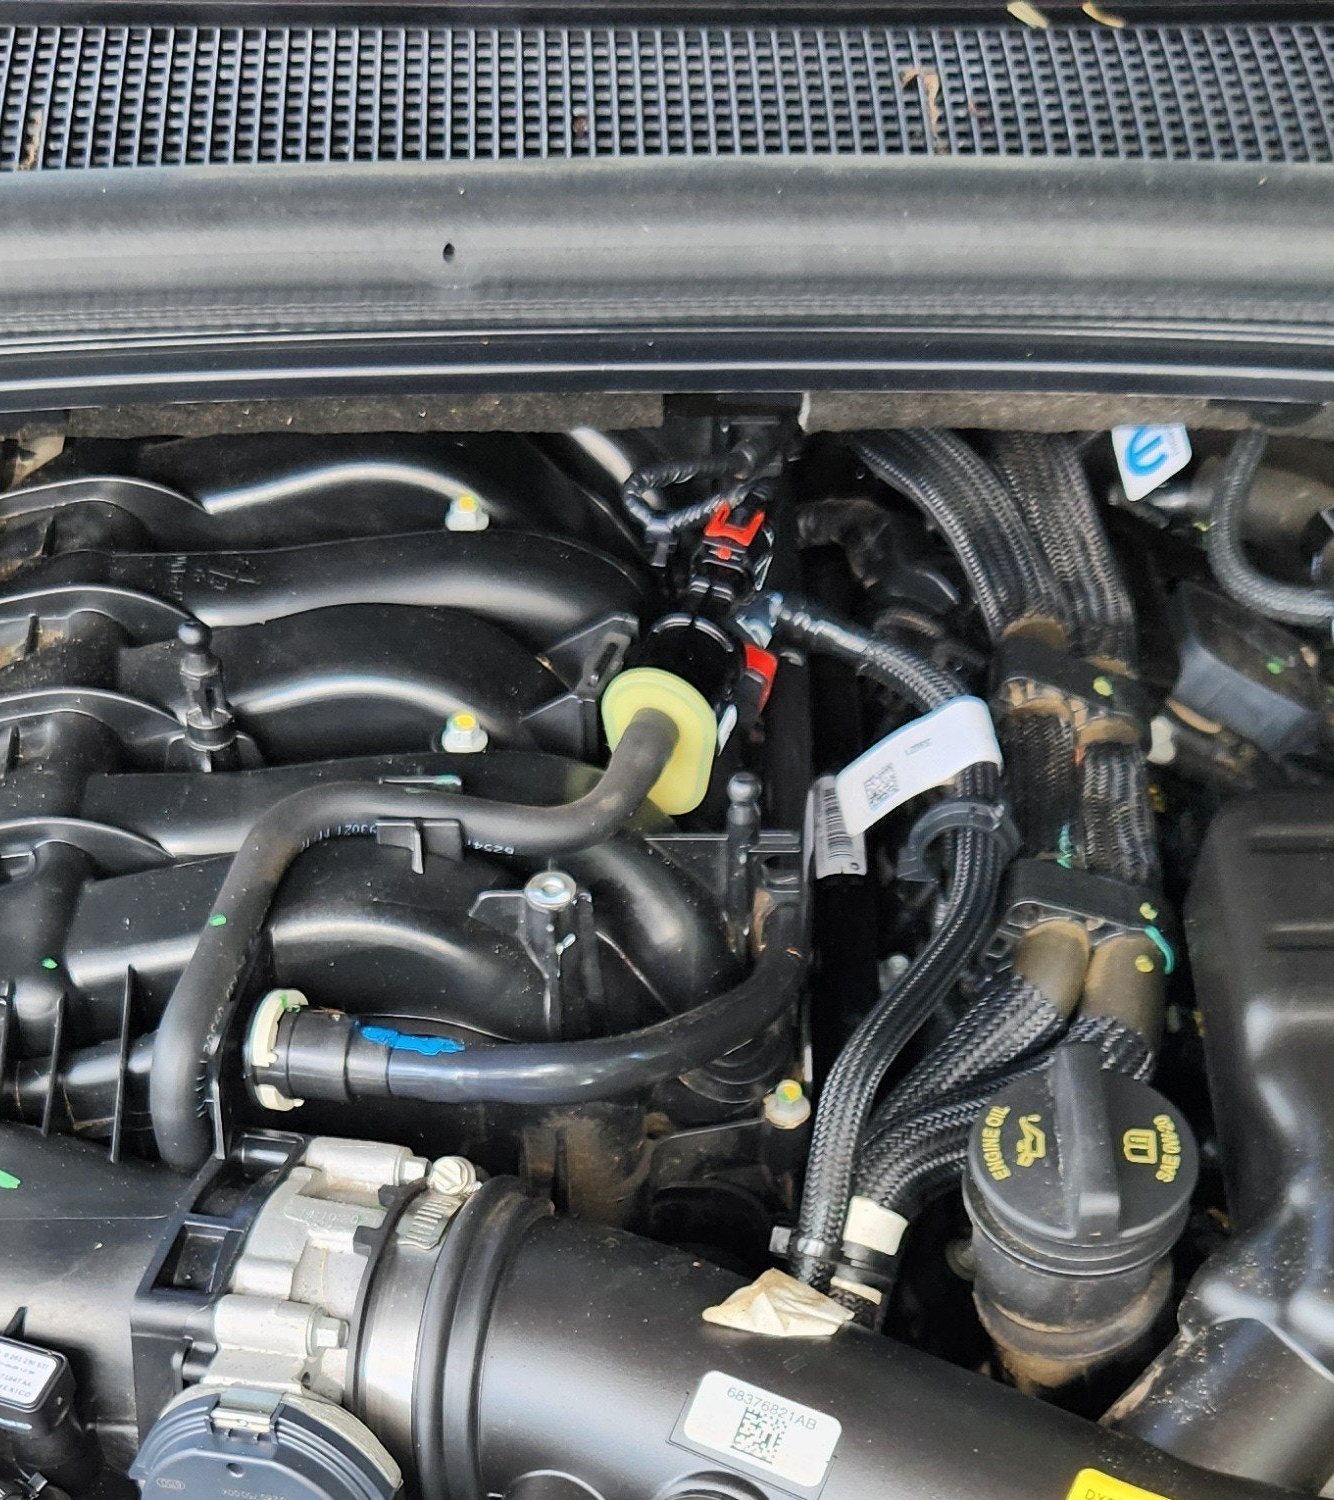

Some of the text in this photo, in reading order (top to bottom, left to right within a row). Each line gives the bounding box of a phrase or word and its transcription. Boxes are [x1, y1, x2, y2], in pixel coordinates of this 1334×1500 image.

[982, 1105, 1012, 1181] ENGINE OIL
[1153, 1114, 1182, 1183] SAE 0W-20
[726, 1387, 818, 1430] 68376821AB
